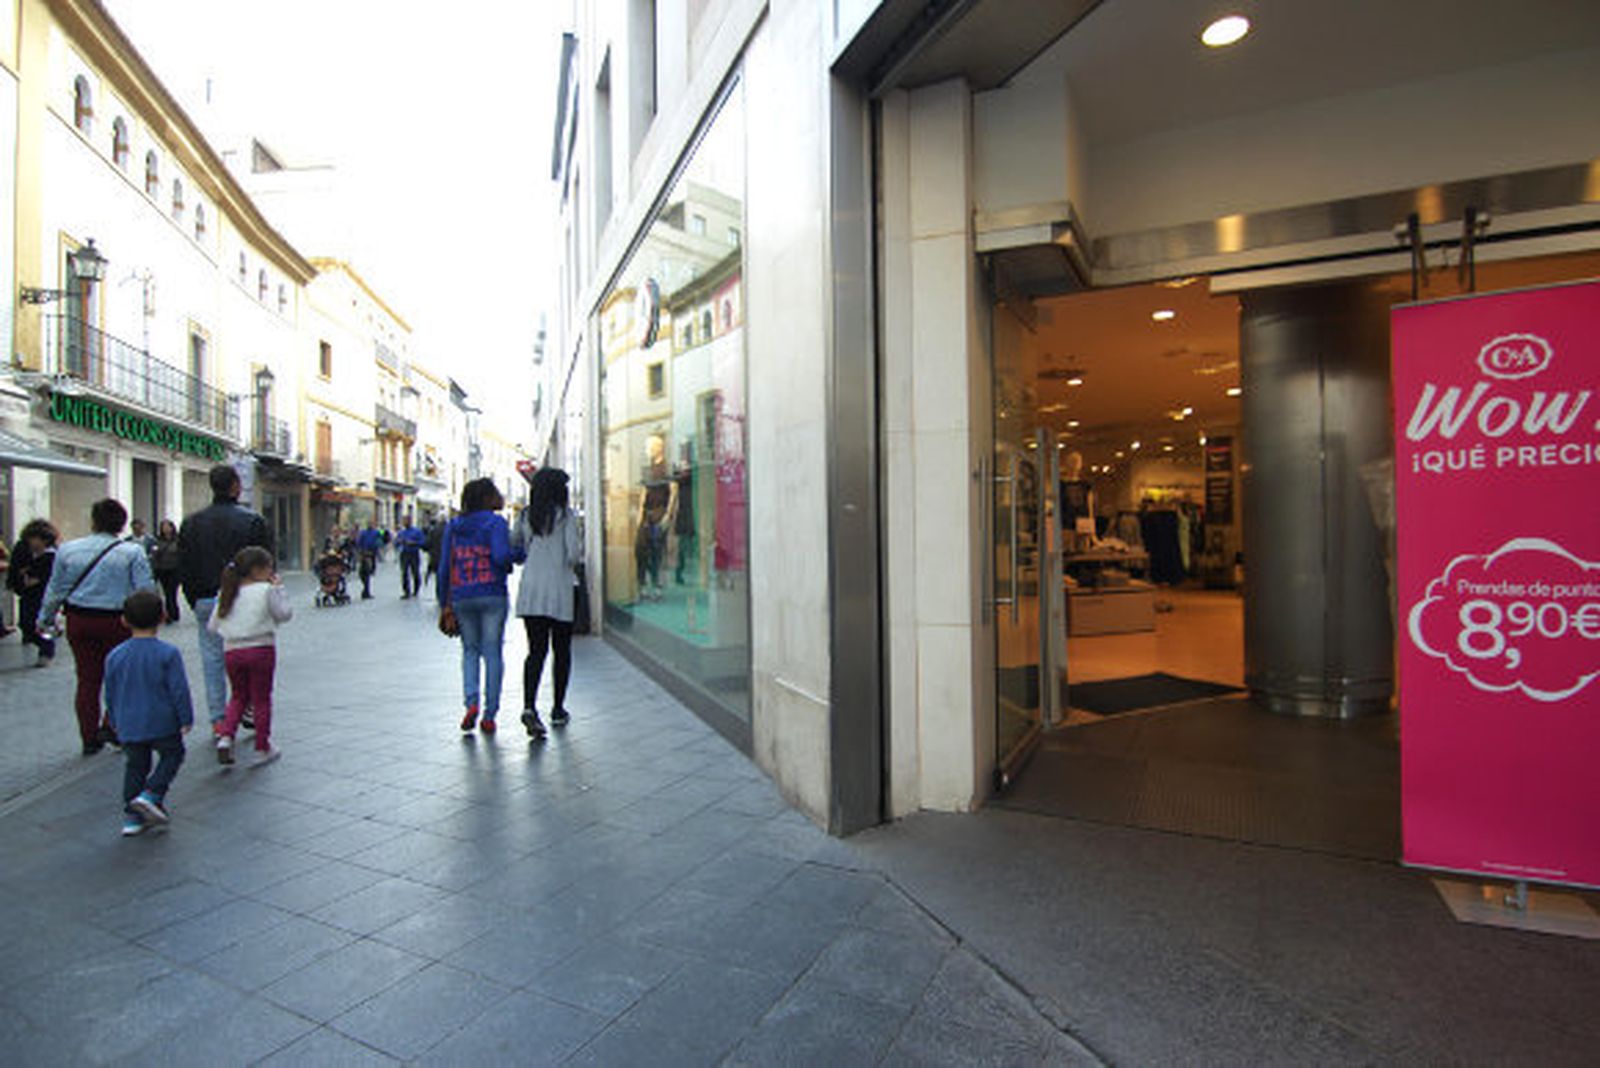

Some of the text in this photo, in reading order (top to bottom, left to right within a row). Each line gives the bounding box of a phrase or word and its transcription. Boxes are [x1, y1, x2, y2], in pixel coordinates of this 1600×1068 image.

[50, 391, 112, 433] UNITED
[1412, 443, 1600, 473] ¡QUÉ PRECI
[1457, 578, 1526, 596] Prendas
[1527, 579, 1551, 597] de
